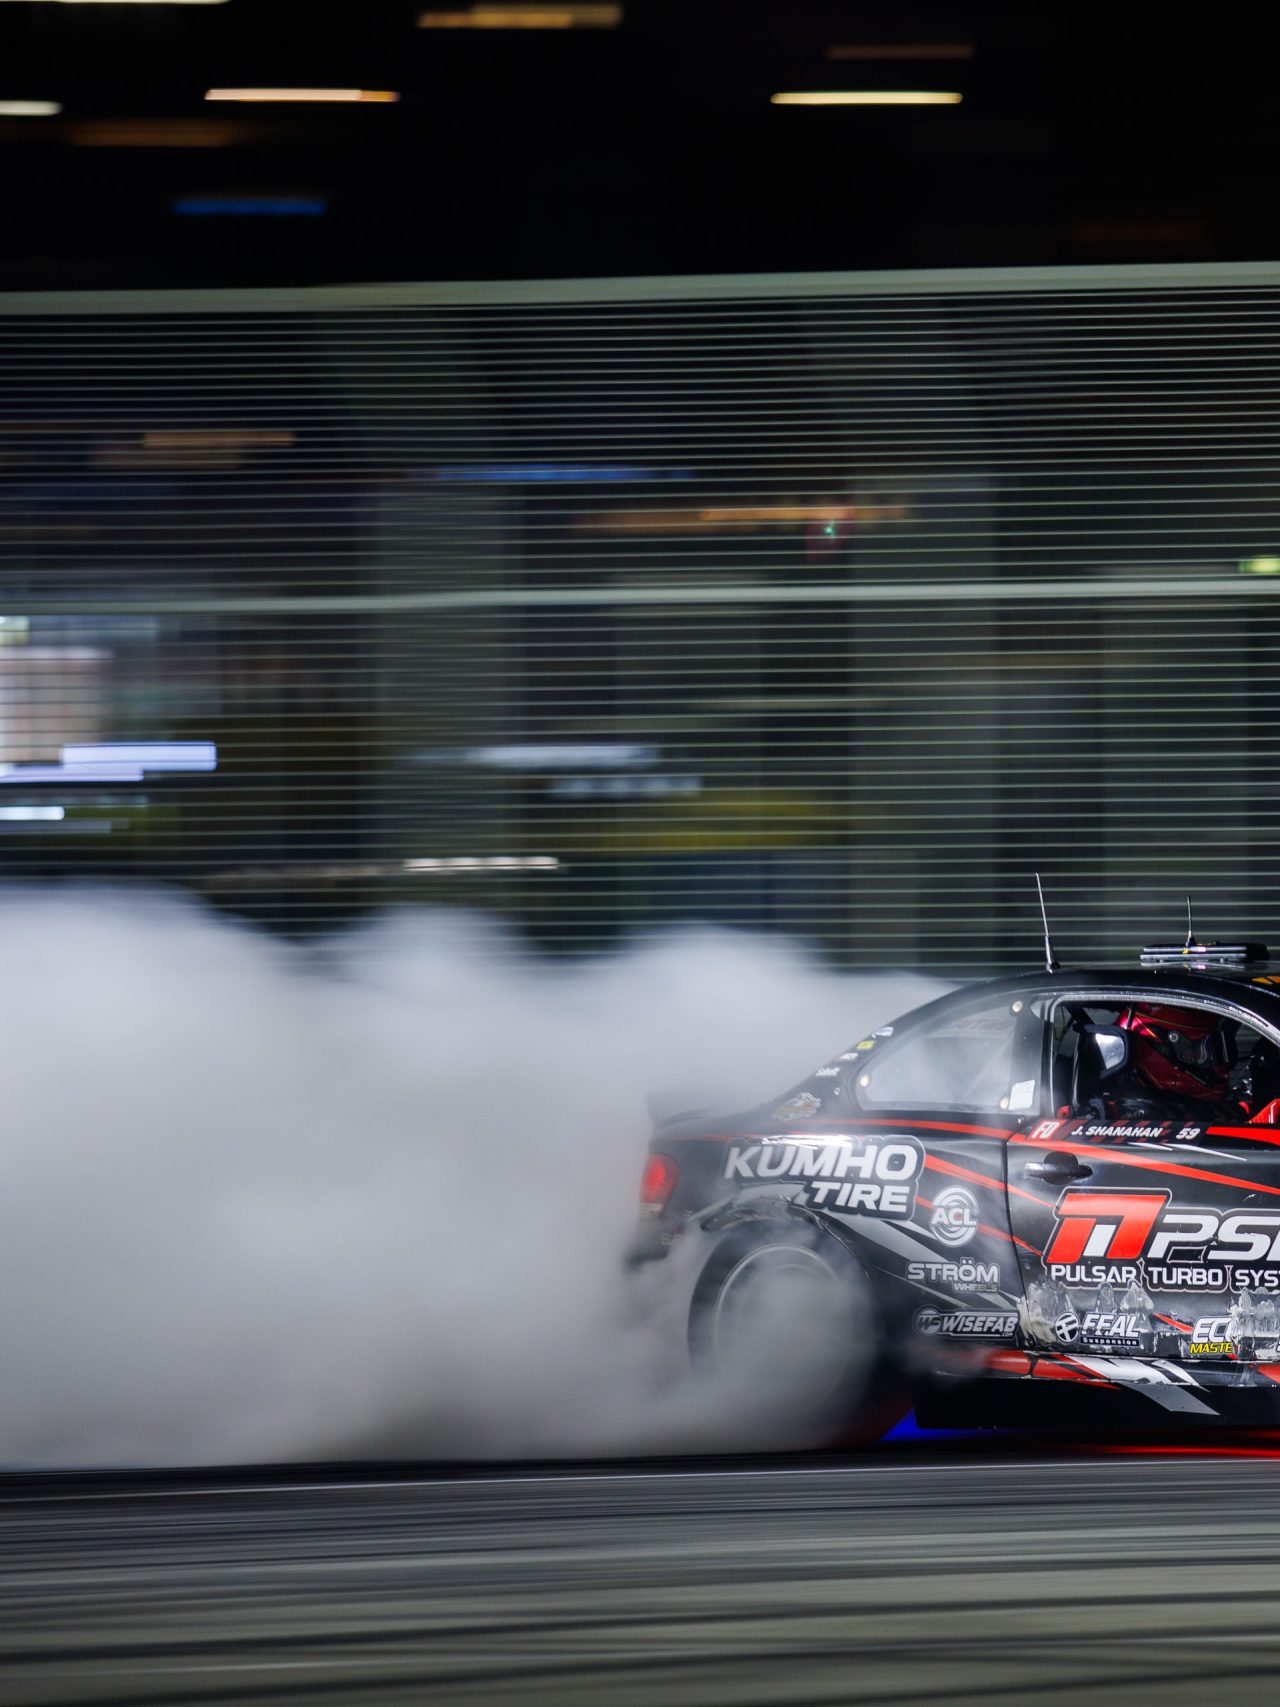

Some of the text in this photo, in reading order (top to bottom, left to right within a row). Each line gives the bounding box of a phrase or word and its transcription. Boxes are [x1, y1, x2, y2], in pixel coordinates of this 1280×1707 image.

[1085, 1126, 1163, 1138] SHANAHAN
[1175, 1127, 1201, 1140] 59
[724, 1143, 918, 1181] KUMHO
[809, 1181, 911, 1213] TIRE
[931, 1207, 978, 1228] ACL
[907, 1259, 999, 1283] STRÖM
[1051, 1264, 1138, 1284] PULSAR
[1147, 1265, 1224, 1286] TURBO
[954, 1283, 998, 1292] WHEELS
[942, 1315, 1019, 1333] WISEFAB
[1082, 1337, 1138, 1346] Suspension
